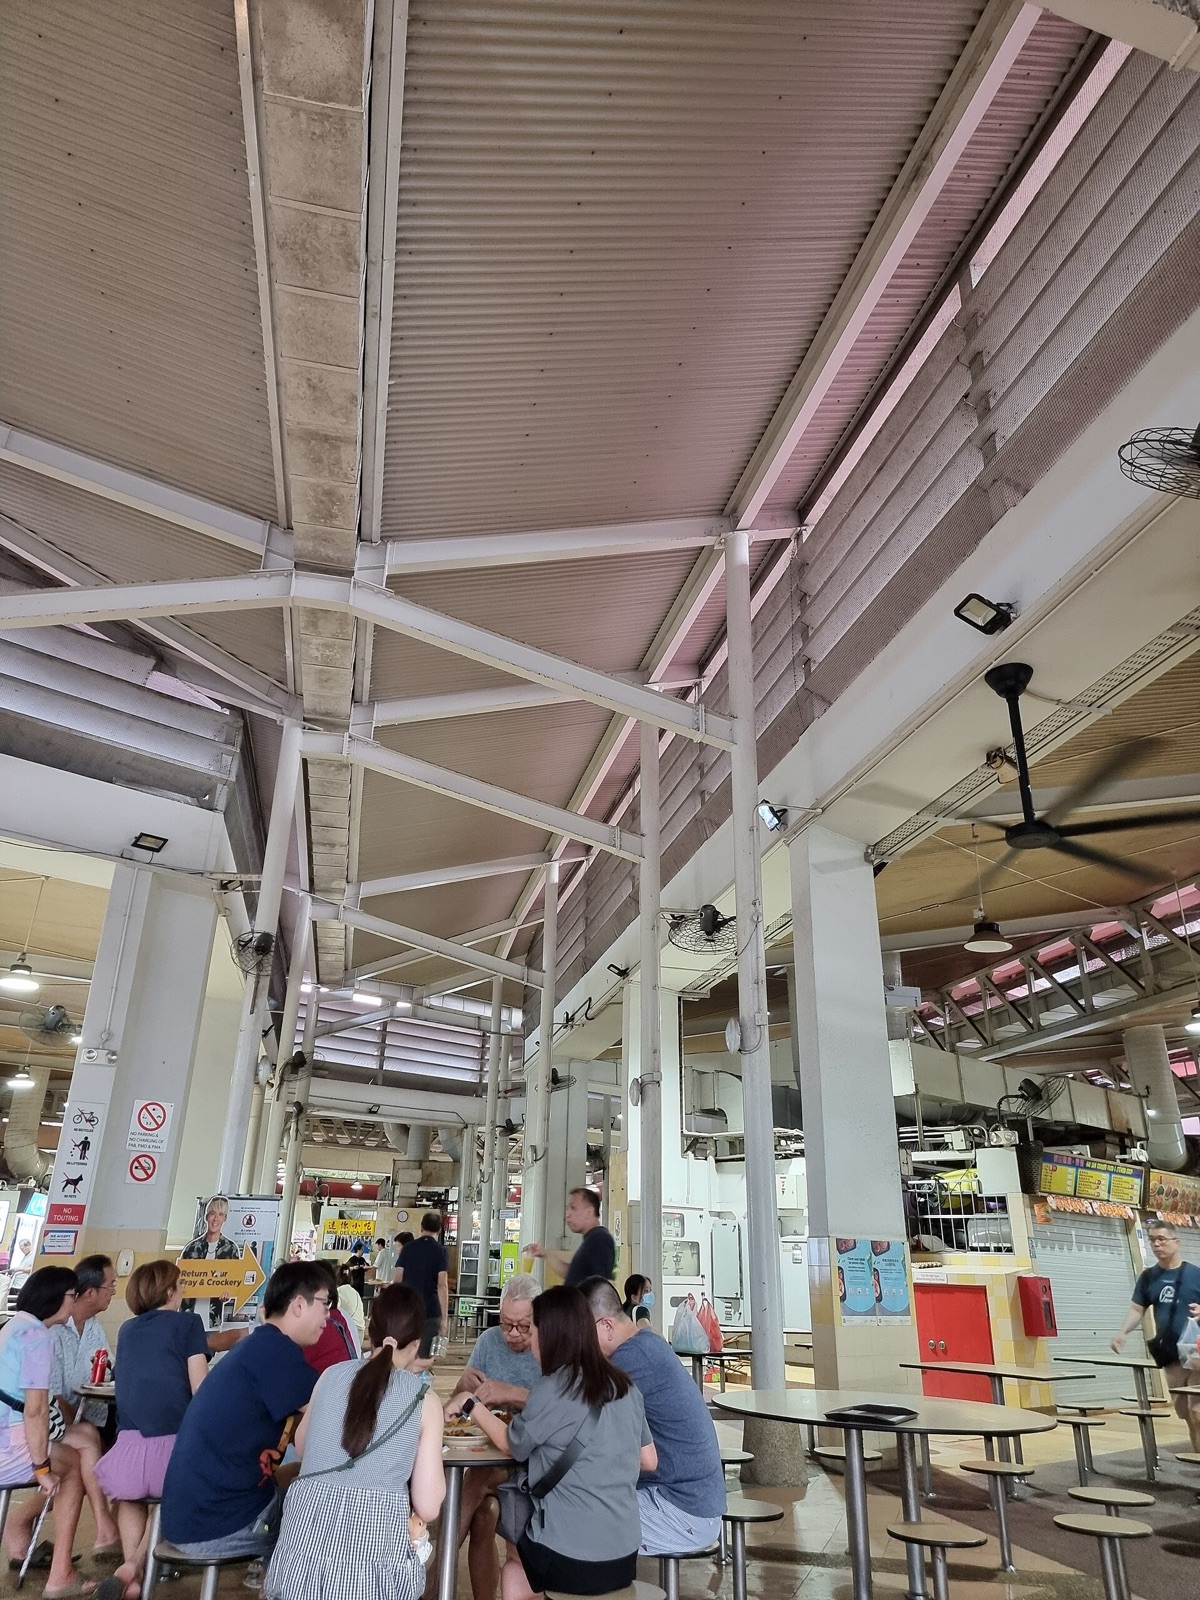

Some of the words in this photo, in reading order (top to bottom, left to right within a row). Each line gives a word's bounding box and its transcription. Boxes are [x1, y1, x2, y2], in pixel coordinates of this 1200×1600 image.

[328, 1221, 371, 1230] 迷你小吃
[207, 1278, 242, 1287] Crockery
